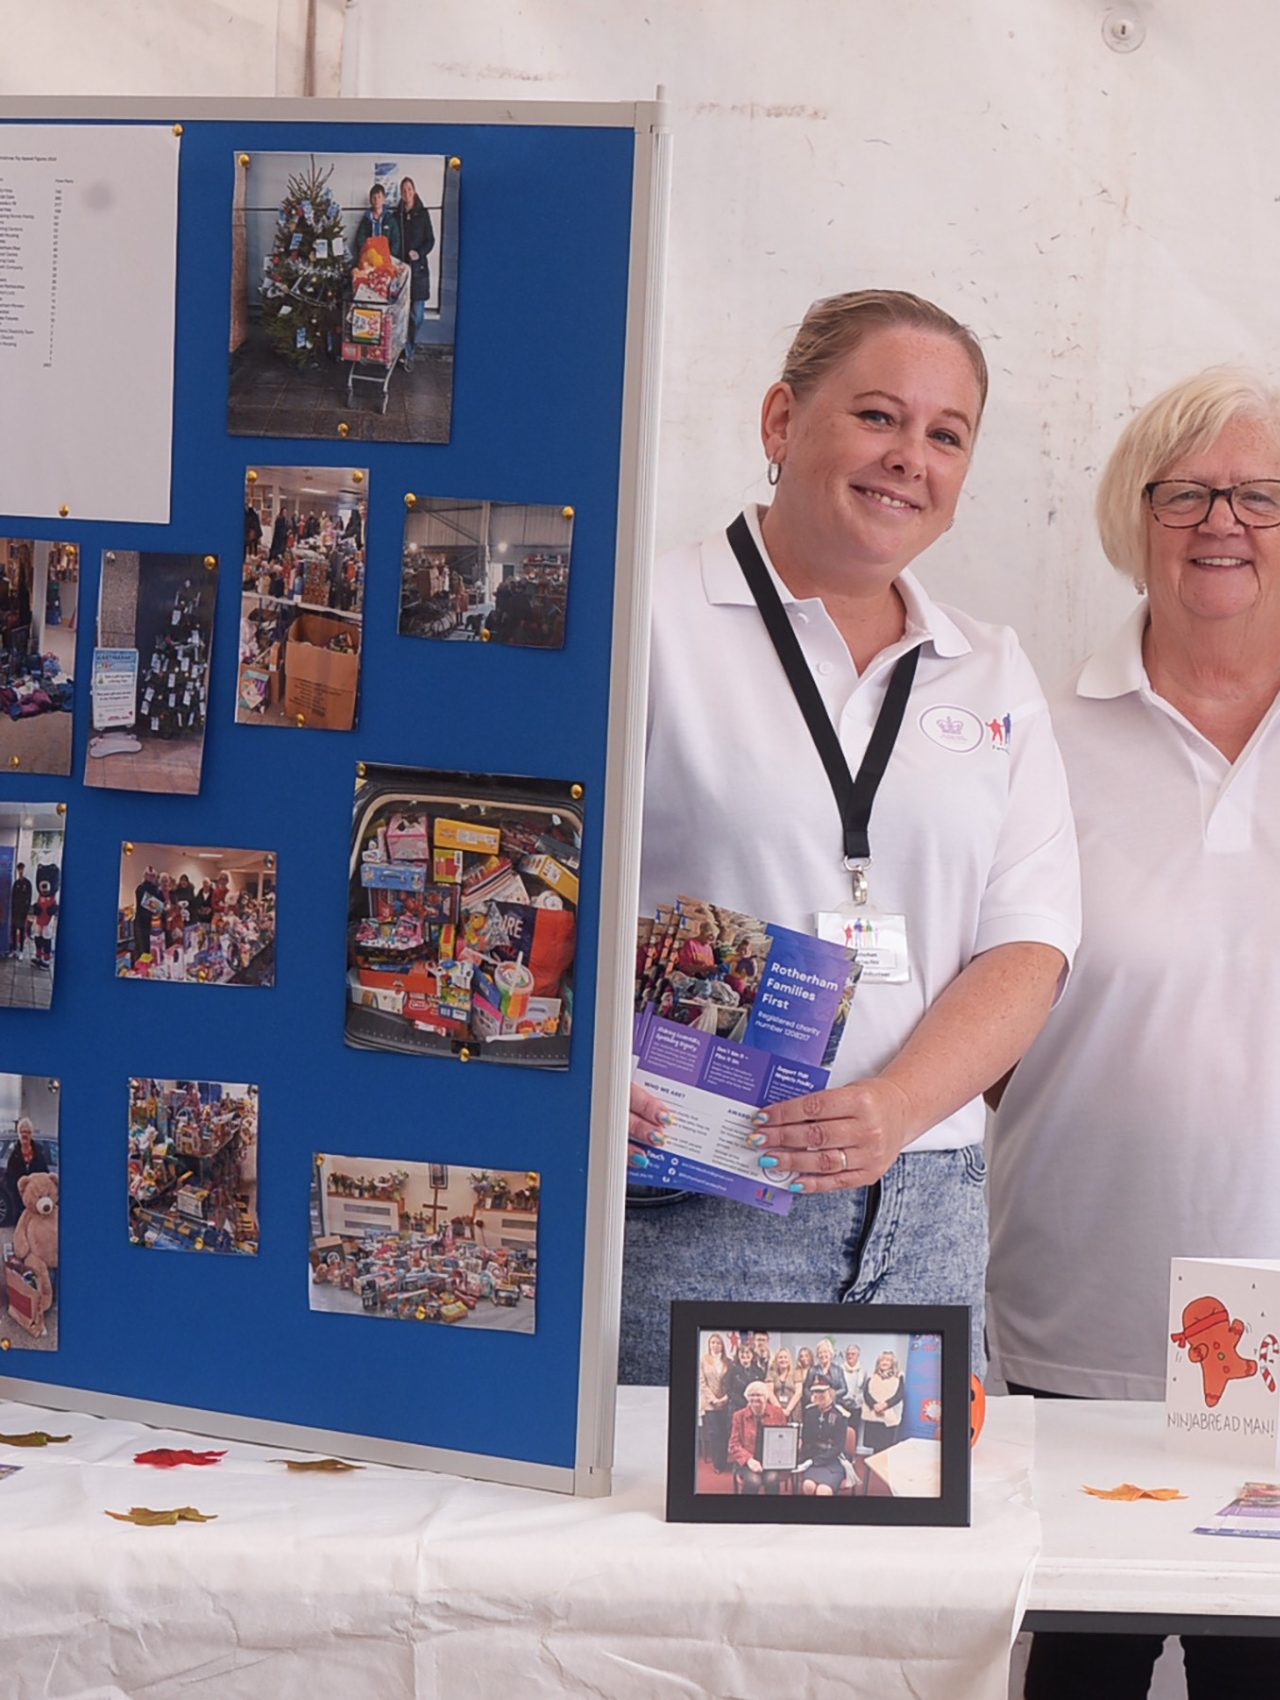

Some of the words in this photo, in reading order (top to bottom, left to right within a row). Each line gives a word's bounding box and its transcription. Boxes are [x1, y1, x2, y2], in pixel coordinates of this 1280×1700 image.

[766, 977, 817, 1001] Families
[770, 962, 839, 992] Rotherham
[761, 993, 790, 1010] First
[1167, 1411, 1241, 1432] NINJABREAD
[1243, 1416, 1275, 1438] MAN!
